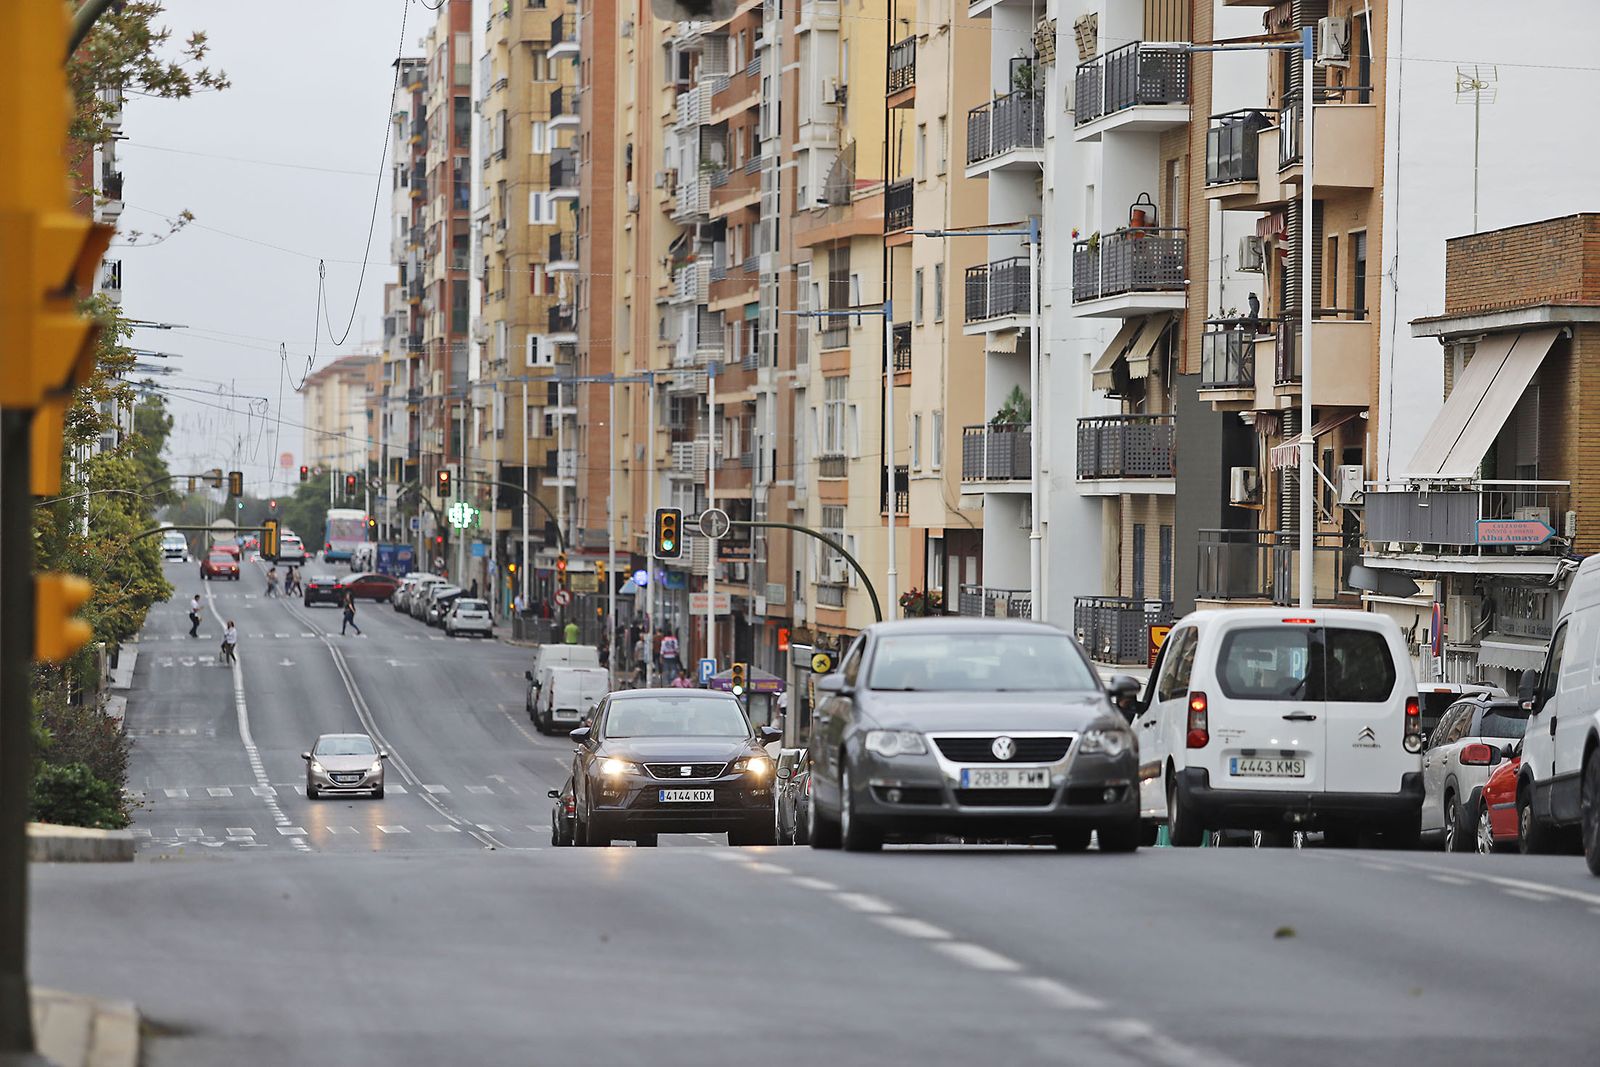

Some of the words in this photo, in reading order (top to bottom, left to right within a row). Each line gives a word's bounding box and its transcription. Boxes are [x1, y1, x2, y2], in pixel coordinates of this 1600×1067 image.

[1506, 534, 1539, 542] Amaya
[703, 662, 713, 681] P
[1240, 761, 1272, 774] 4443
[1276, 761, 1301, 774] KMS
[974, 772, 1009, 785] 2838
[666, 791, 690, 801] 4144
[693, 791, 712, 801] KDX
